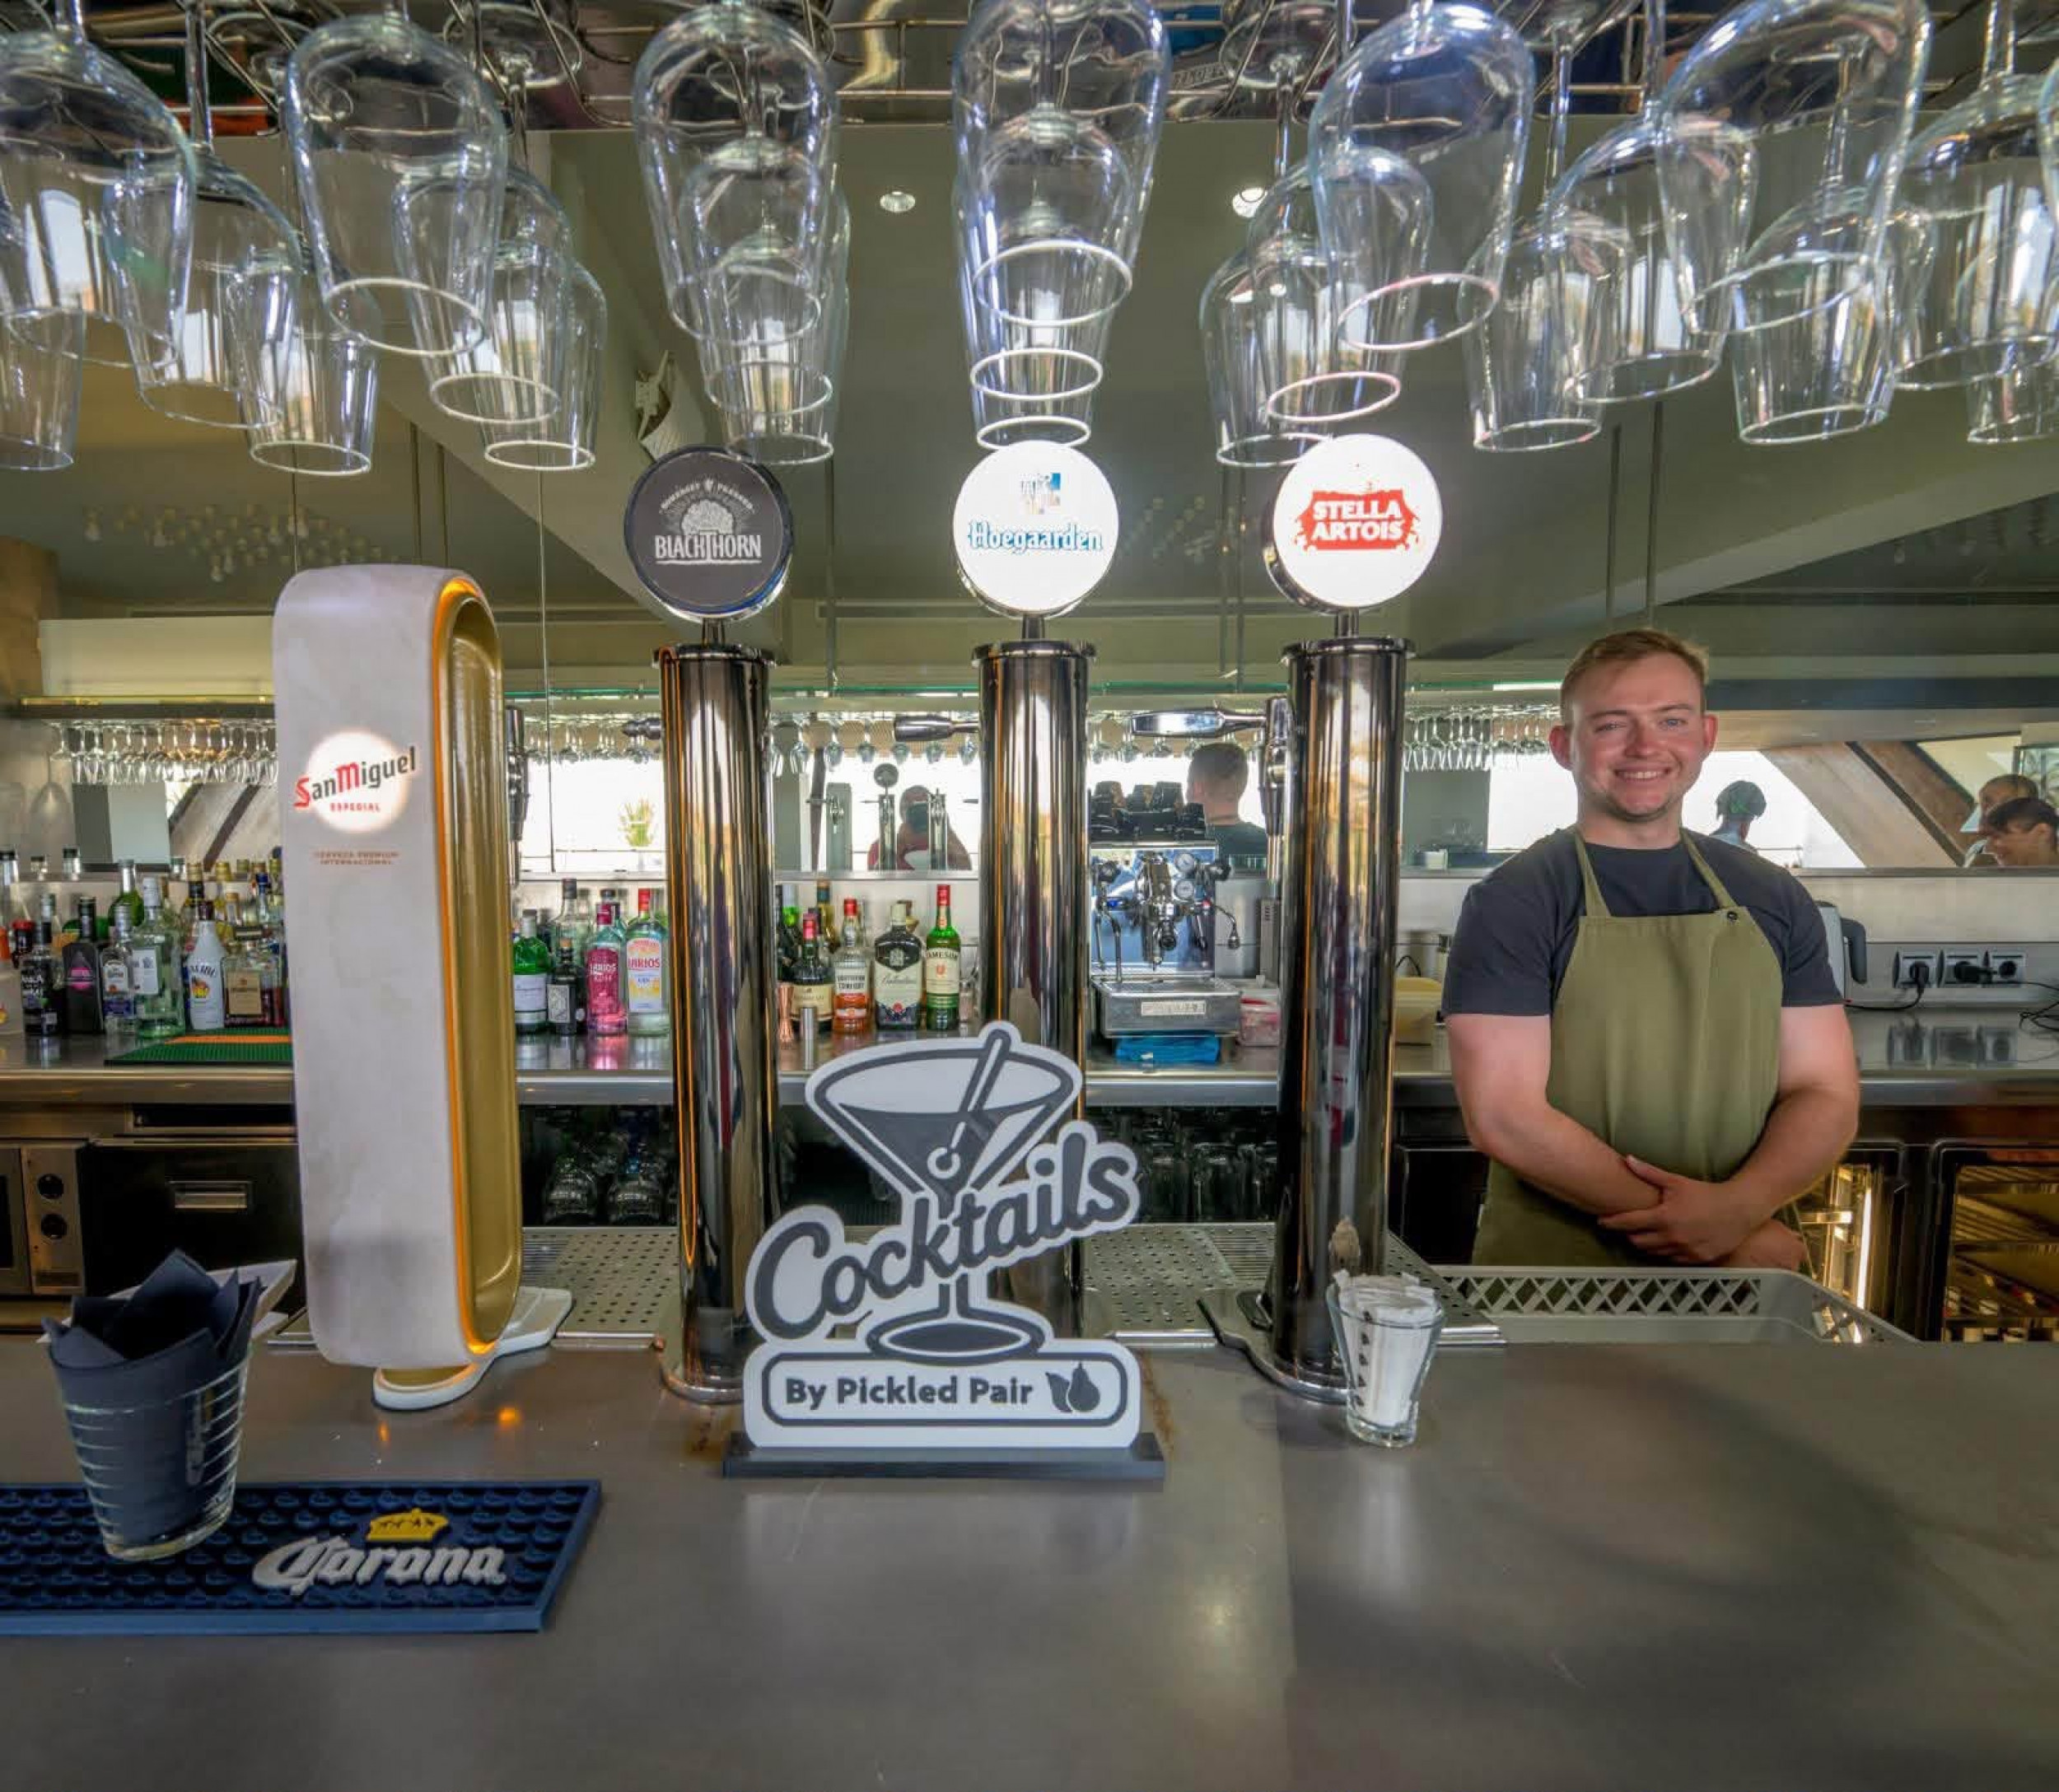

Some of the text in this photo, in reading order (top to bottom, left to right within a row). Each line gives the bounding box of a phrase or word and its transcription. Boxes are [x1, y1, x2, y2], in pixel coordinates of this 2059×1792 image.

[1313, 500, 1402, 519] STELLA
[968, 519, 1103, 554] Hoegaarden
[1311, 520, 1403, 541] ARTOIS
[655, 534, 762, 563] BLACKTHORN
[330, 802, 381, 813] ESPECIAL
[754, 1132, 1130, 1340] Cocktails
[786, 1374, 1034, 1410] By Pickled Pair
[252, 1536, 507, 1596] Corona
